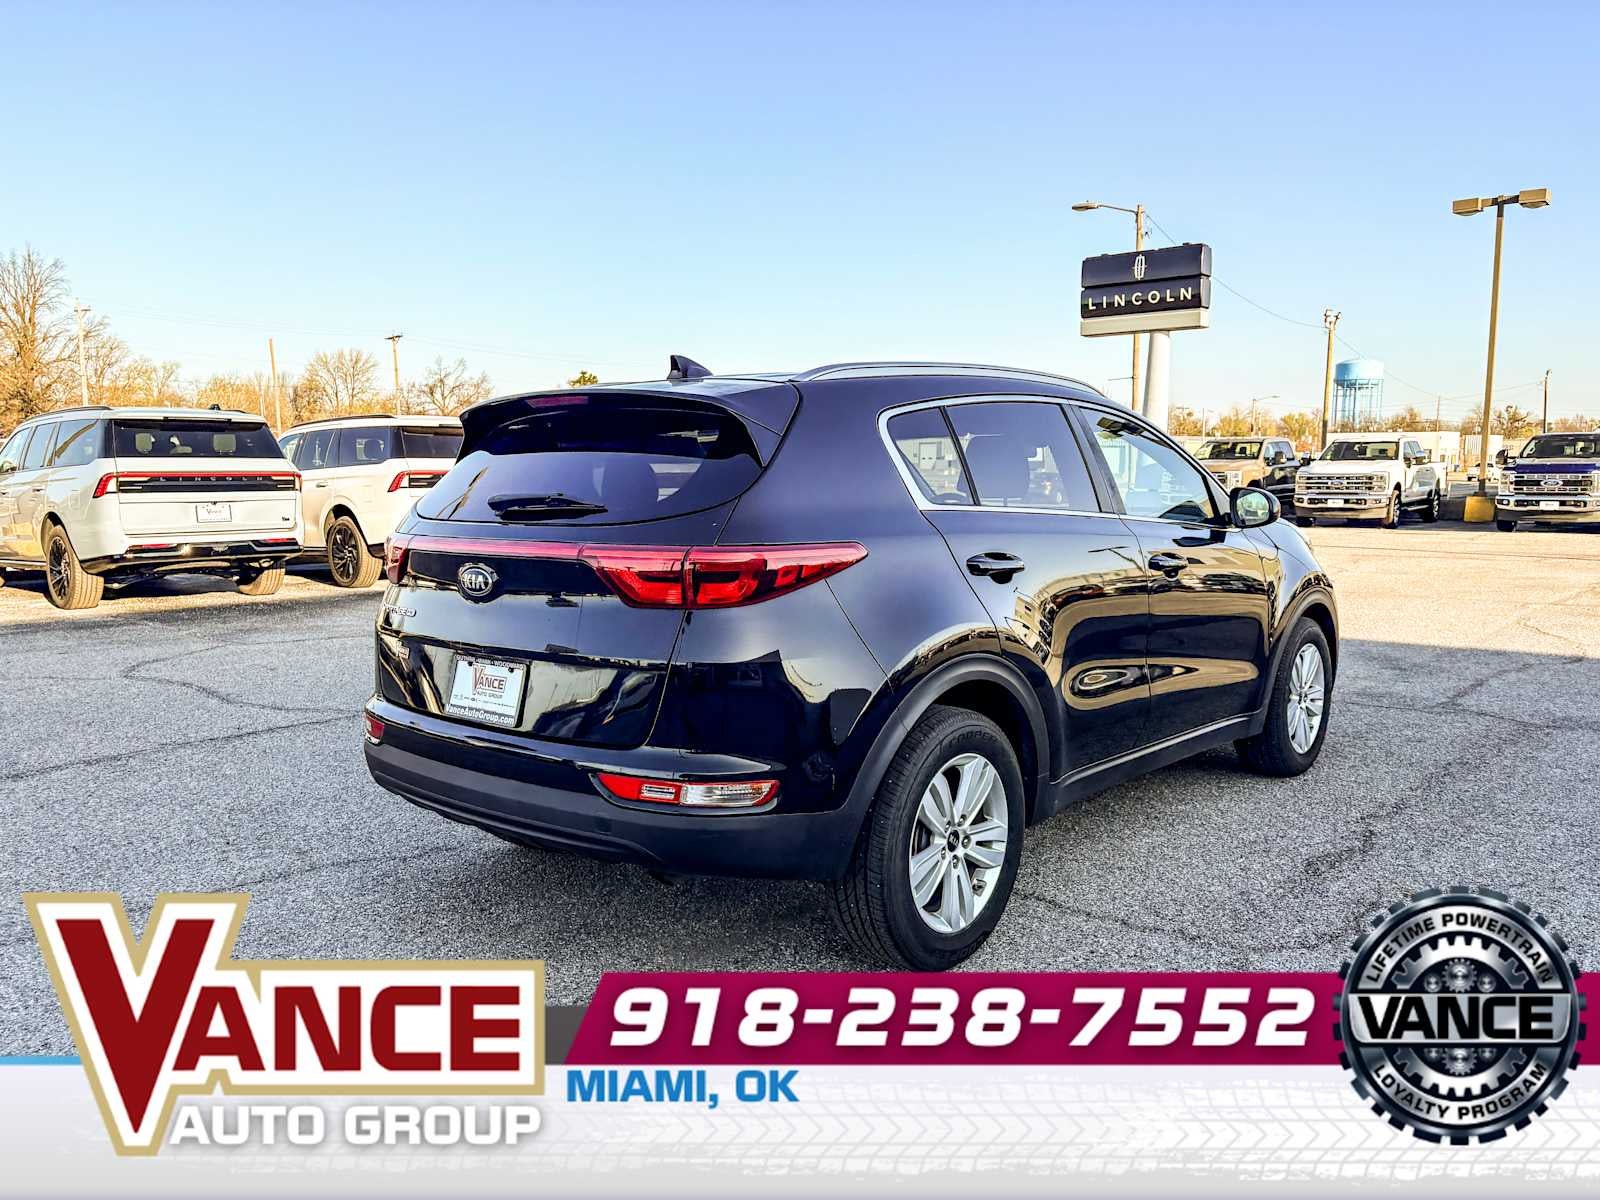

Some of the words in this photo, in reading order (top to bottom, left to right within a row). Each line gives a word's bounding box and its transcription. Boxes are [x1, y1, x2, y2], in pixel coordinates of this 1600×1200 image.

[1088, 287, 1192, 310] LINCOLN
[463, 573, 486, 589] KIA
[473, 666, 505, 690] VANCE
[446, 704, 514, 725] VanceAutoGroup.com
